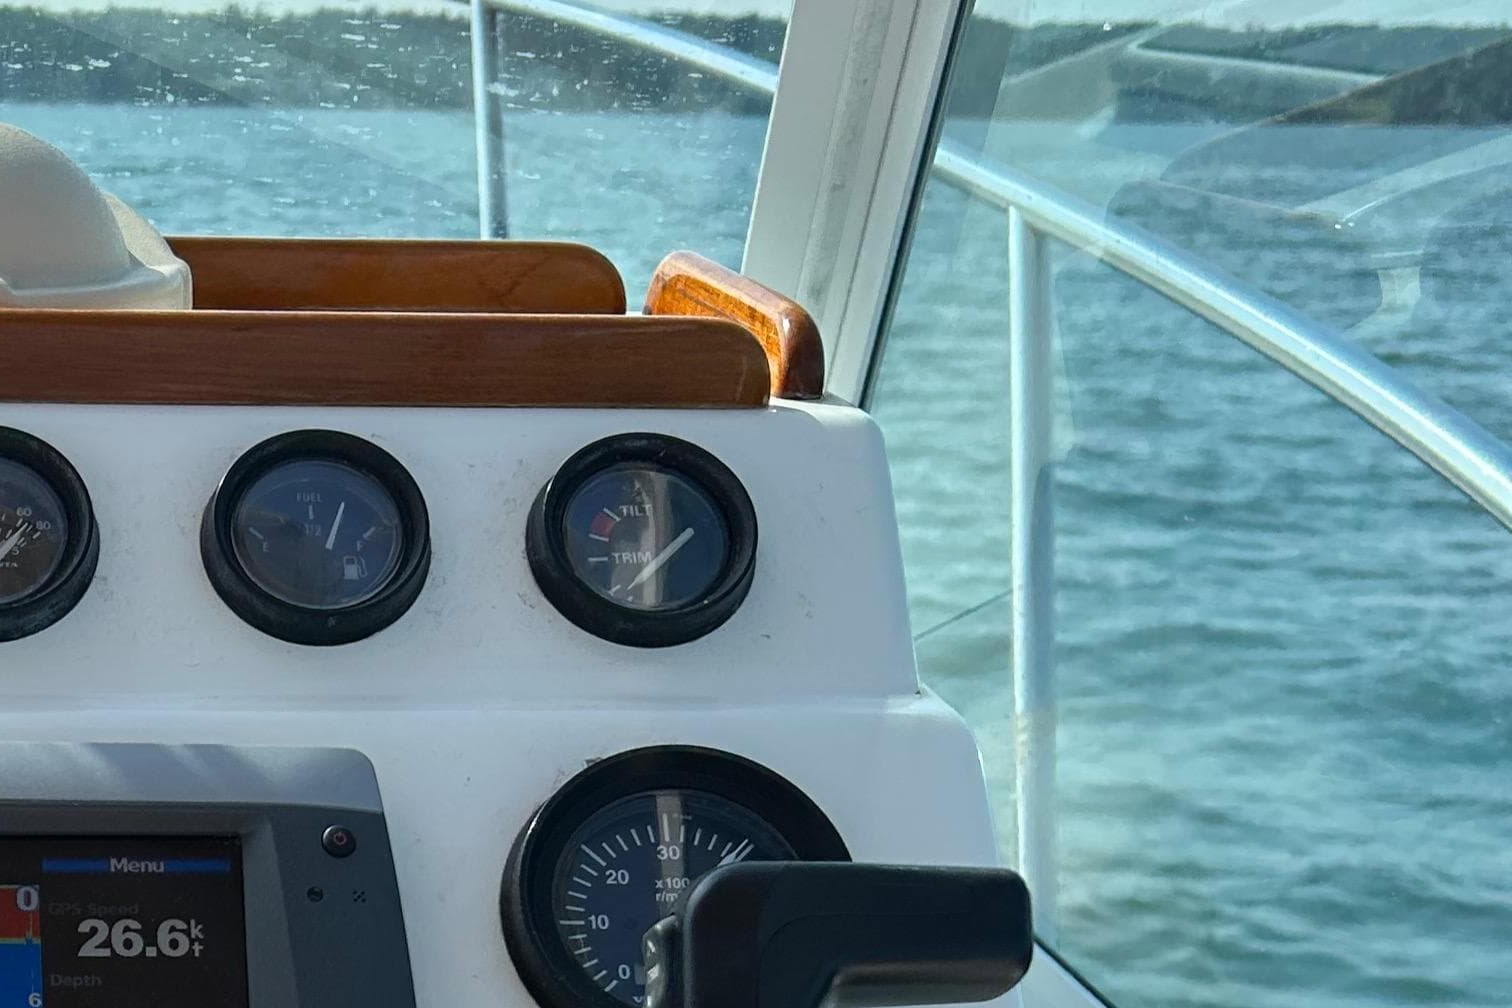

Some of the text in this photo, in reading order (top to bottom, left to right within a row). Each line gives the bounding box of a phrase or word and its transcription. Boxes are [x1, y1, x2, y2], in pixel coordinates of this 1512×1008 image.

[296, 491, 322, 502] FUEL
[16, 507, 32, 517] 60
[619, 503, 652, 517] TILT
[11, 546, 20, 556] 5
[262, 543, 270, 552] E
[356, 540, 365, 552] F
[611, 551, 652, 565] TRIM
[656, 845, 680, 860] 30
[109, 857, 165, 873] Menu
[606, 870, 629, 885] 20
[16, 886, 39, 911] 0
[590, 915, 609, 929] 10
[618, 965, 630, 979] 0
[50, 974, 102, 989] Depth
[28, 993, 42, 1007] 6
